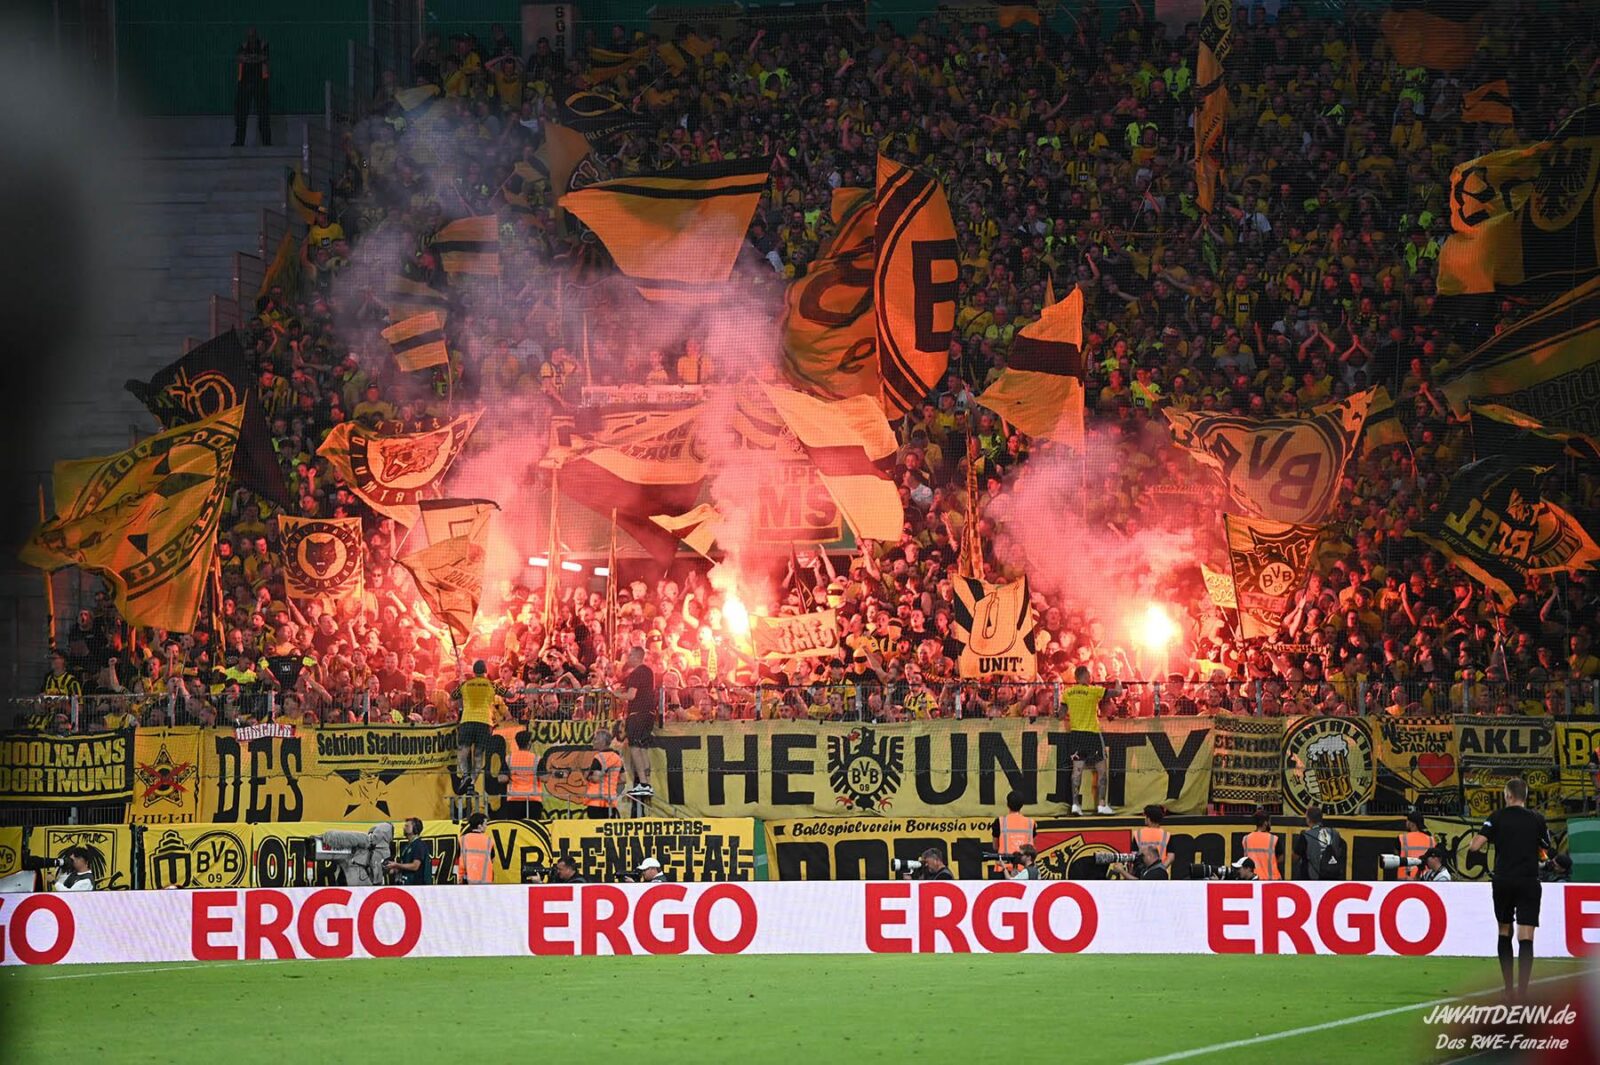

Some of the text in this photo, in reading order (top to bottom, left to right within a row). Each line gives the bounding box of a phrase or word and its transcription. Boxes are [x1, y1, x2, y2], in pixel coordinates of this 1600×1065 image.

[1262, 565, 1293, 588] BVB
[0, 738, 126, 767] HOOLIGANS
[317, 733, 364, 756] Sektion
[1392, 741, 1446, 755] STADION
[1459, 728, 1551, 753] AKLP
[0, 764, 126, 793] DORTMUND
[653, 728, 1211, 807] THE UNITY
[851, 760, 878, 785] BVB
[792, 821, 901, 838] Ballspielverein
[905, 819, 967, 834] Borussia
[197, 841, 239, 873] BVB
[208, 873, 222, 884] 09
[191, 888, 421, 961] ERGO
[528, 883, 758, 956] ERGO
[865, 881, 1098, 955] ERGO
[1206, 882, 1447, 957] ERGO
